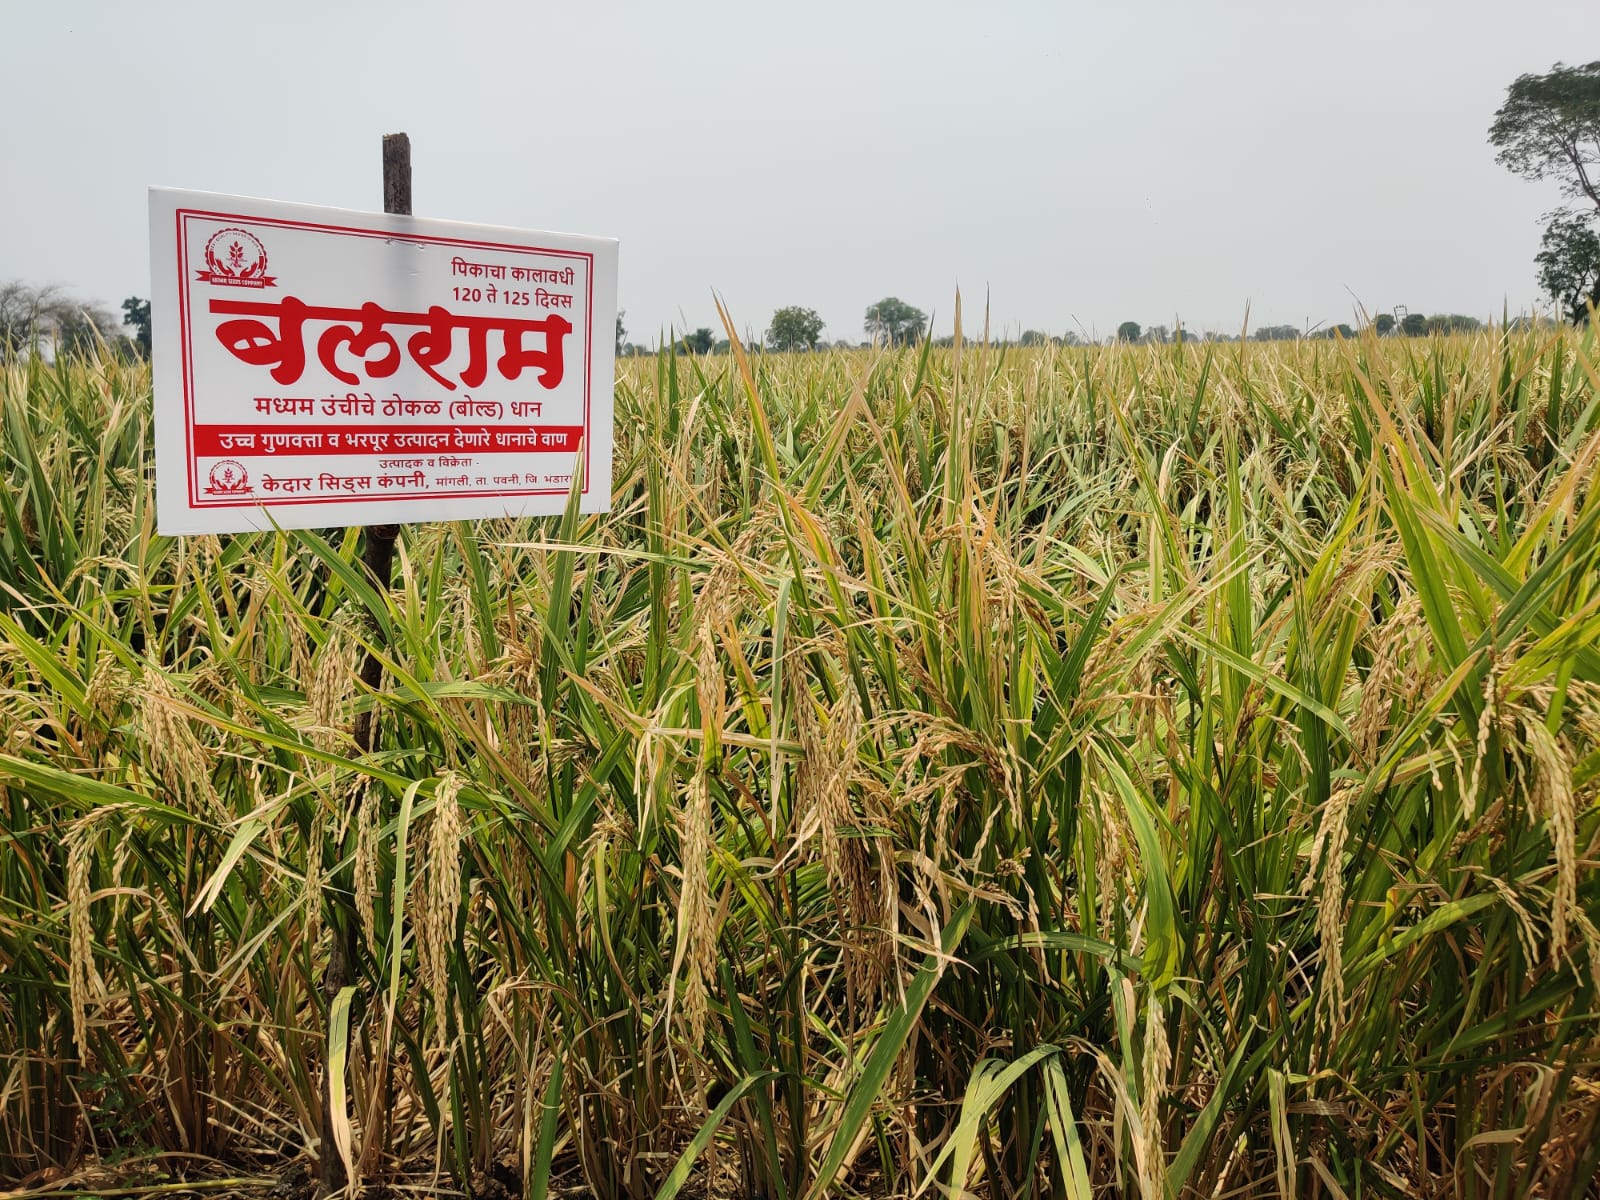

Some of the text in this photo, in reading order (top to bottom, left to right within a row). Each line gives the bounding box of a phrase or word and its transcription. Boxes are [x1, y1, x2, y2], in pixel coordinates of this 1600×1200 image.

[451, 257, 575, 286] पिकाचा कालावधी
[453, 283, 574, 310] 120 ते 125 दिवस
[209, 296, 573, 391] बलराम
[252, 393, 543, 420] मध्यम उंचीचे ठोकळ (बोल्ड) धान
[219, 428, 568, 453] उच्च गुणवत्ता व भरपूर उत्पादन देणारे धानाचे वाण
[379, 458, 424, 469] उत्पादक
[426, 458, 435, 467] व
[438, 456, 472, 468] विक्रेता
[261, 473, 313, 493] केदार
[318, 472, 372, 493] सिड्स
[376, 470, 430, 489] कंपनी,
